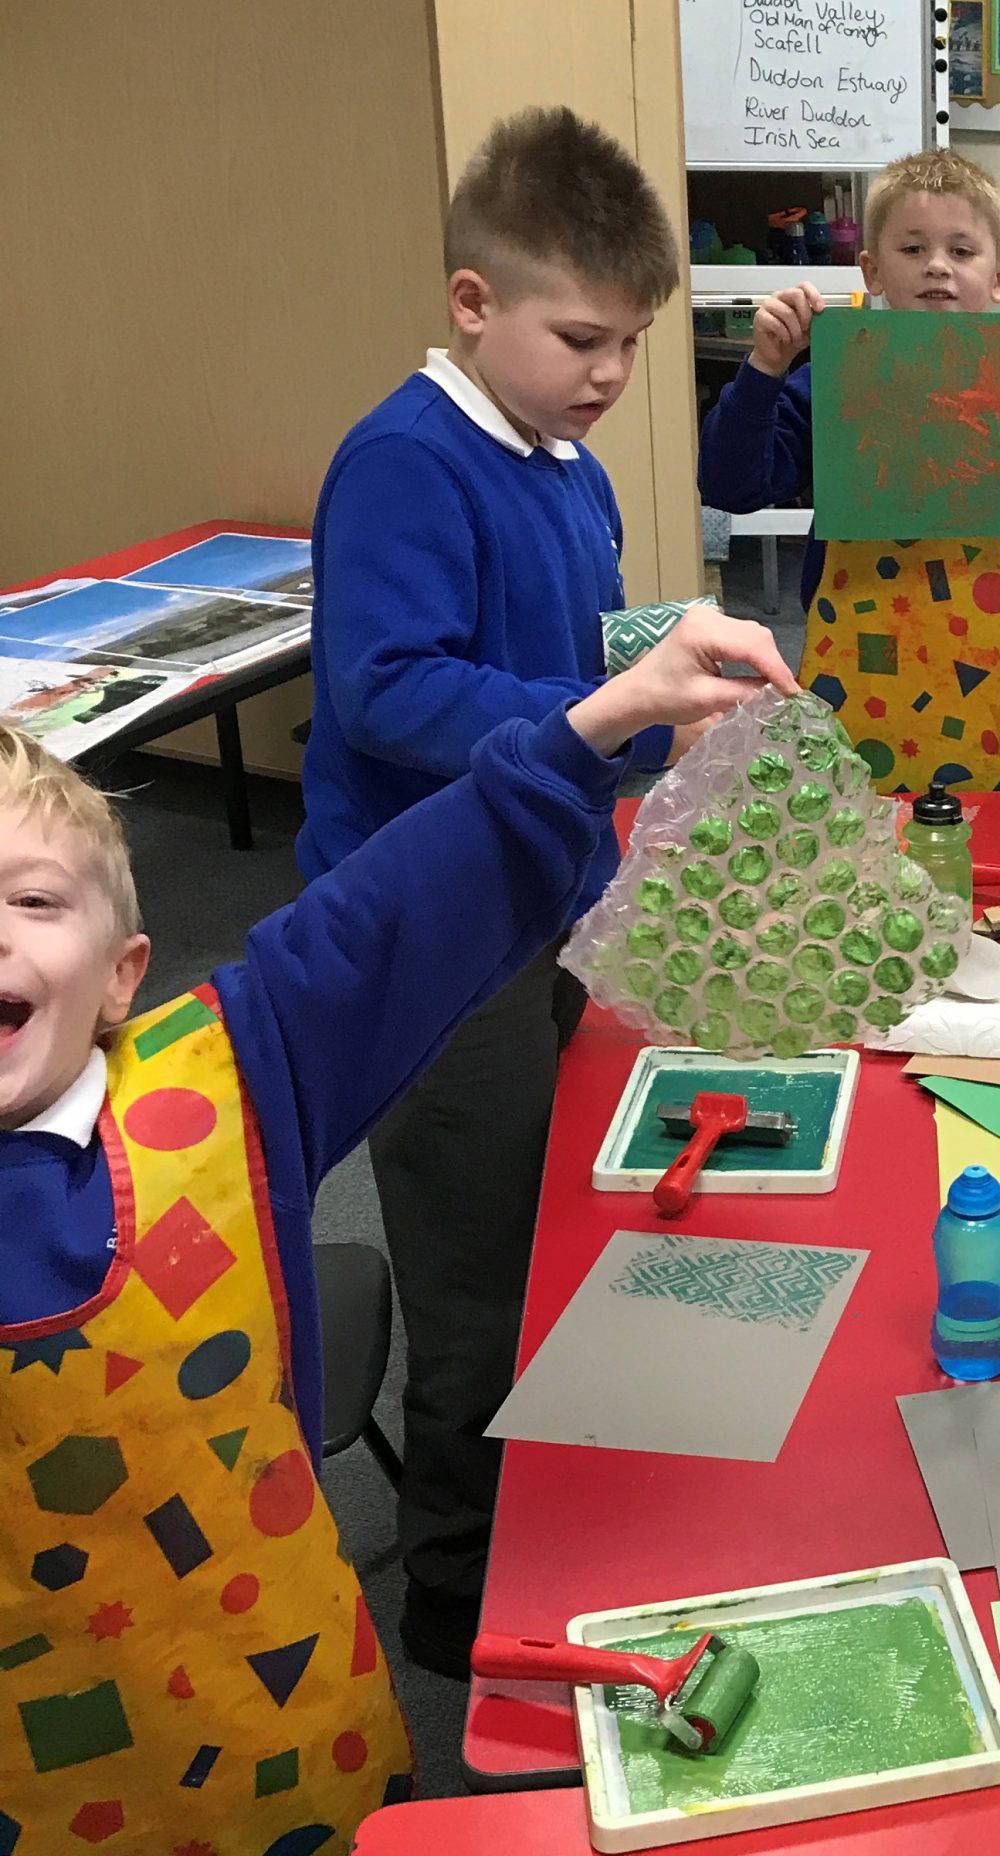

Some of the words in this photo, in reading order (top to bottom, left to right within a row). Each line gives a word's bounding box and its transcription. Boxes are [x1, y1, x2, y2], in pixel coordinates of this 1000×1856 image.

[750, 9, 779, 26] Old
[785, 12, 813, 30] Man
[818, 20, 836, 34] of
[816, 1, 885, 28] Valley
[754, 29, 821, 54] Scafell
[750, 57, 823, 88] Duddon
[837, 67, 907, 104] Estuary
[745, 97, 789, 121] River
[801, 100, 871, 127] Duddon
[744, 127, 801, 149] Irish
[806, 129, 840, 149] Sea
